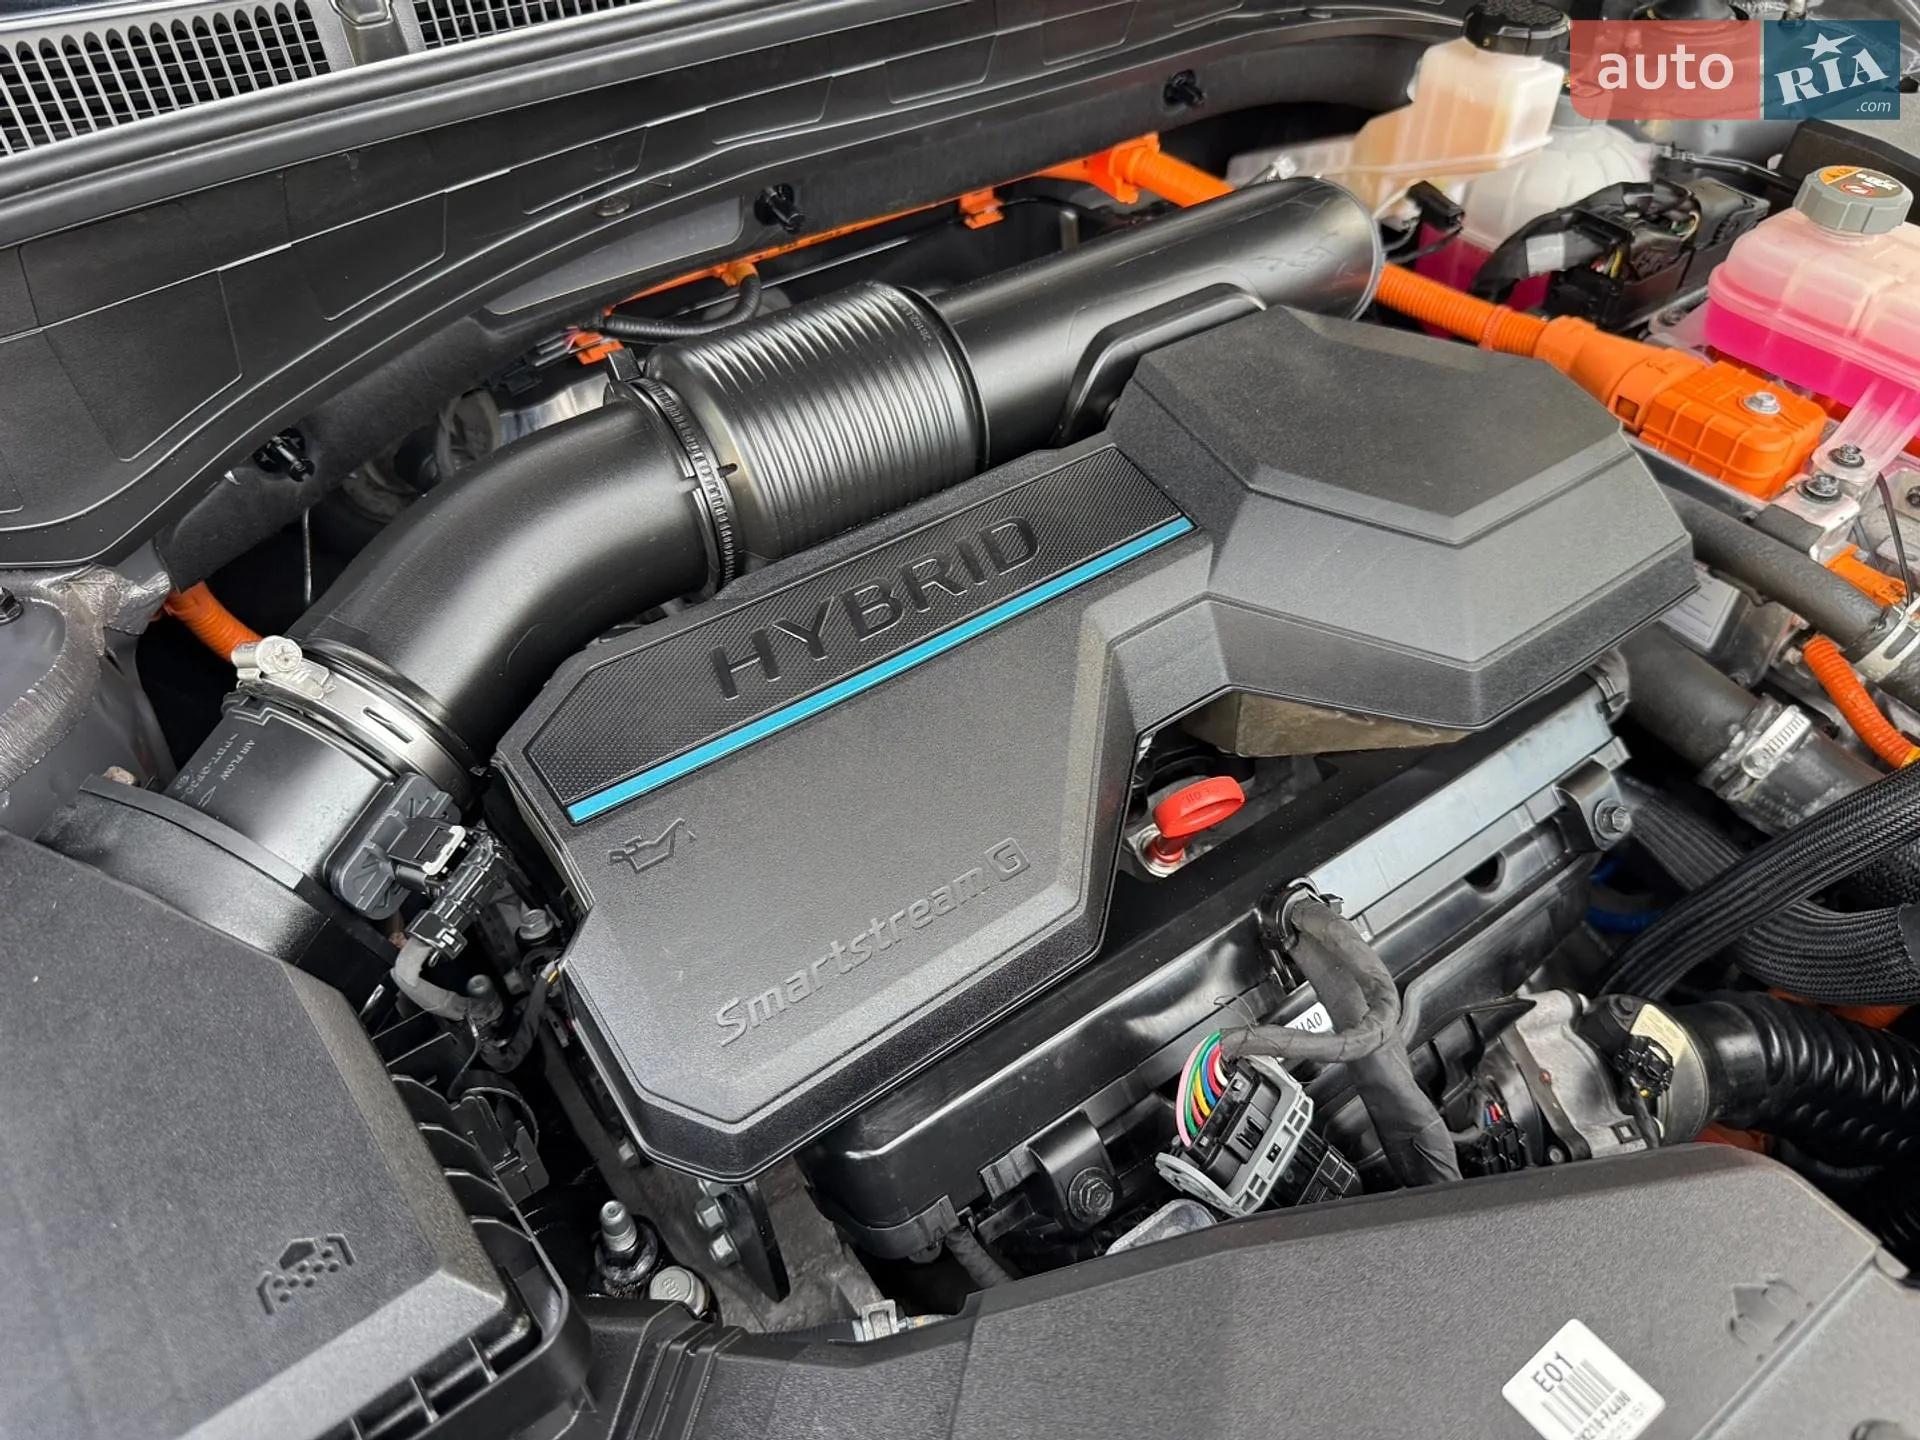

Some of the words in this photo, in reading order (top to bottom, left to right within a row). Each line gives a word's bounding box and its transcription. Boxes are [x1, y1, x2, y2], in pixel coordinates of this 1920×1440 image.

[711, 516, 1040, 701] HYBRID
[714, 866, 991, 1048] Smartstream
[991, 842, 1024, 876] G
[1530, 1351, 1574, 1393] E01
